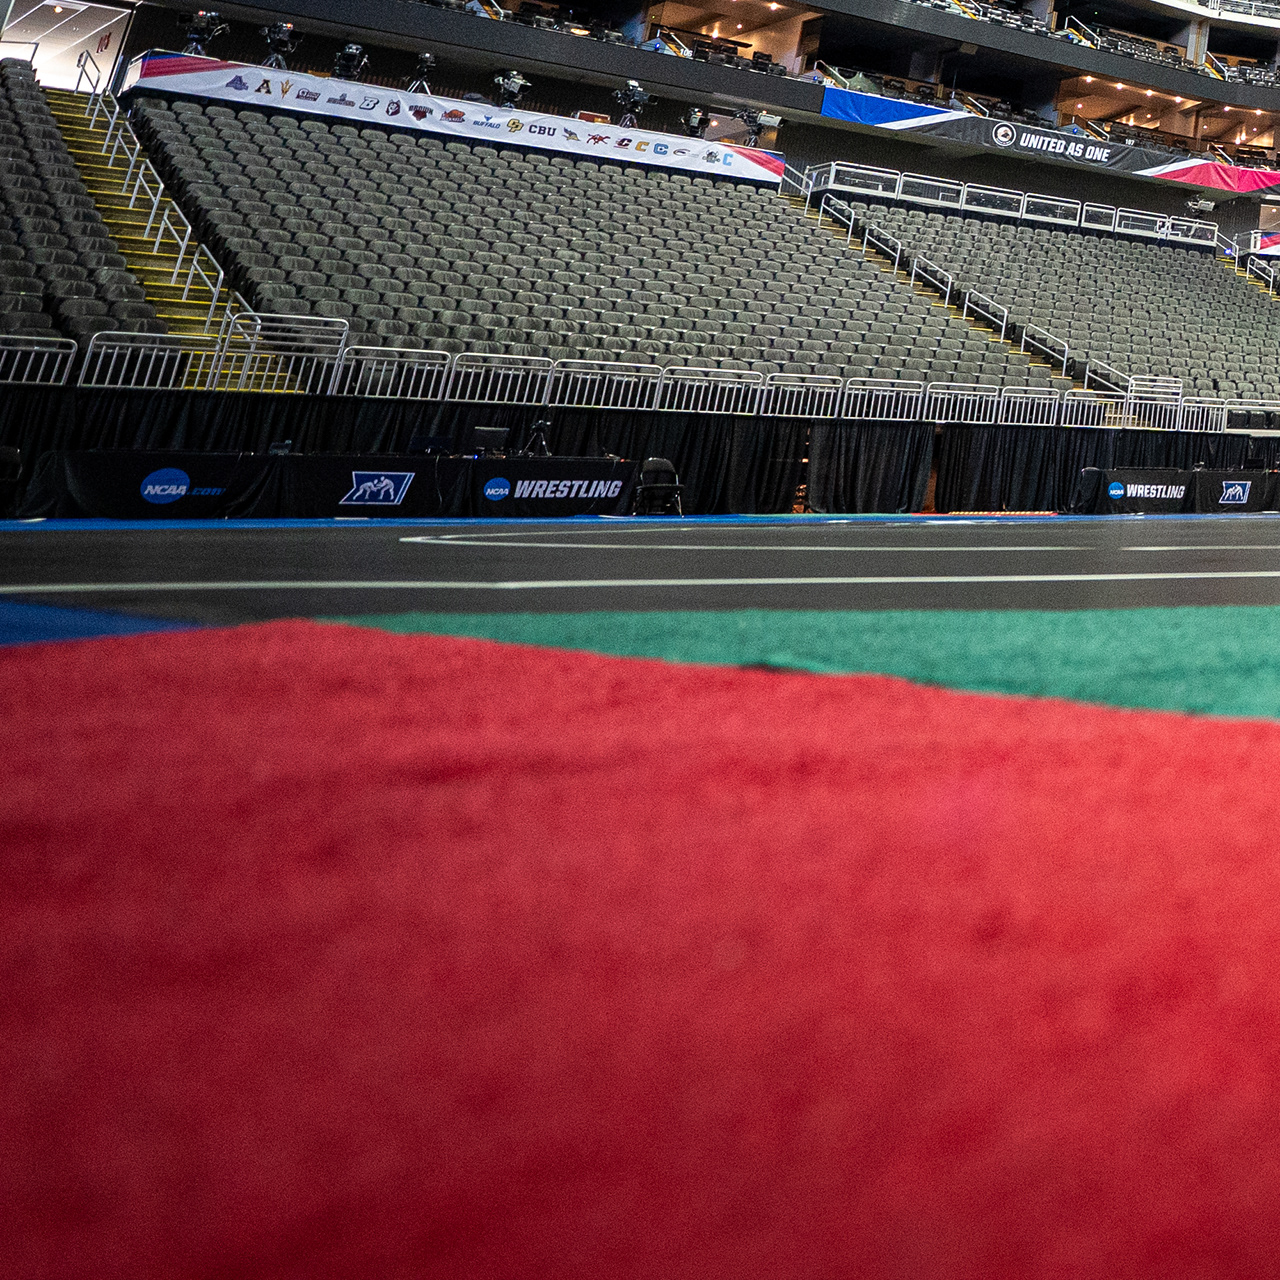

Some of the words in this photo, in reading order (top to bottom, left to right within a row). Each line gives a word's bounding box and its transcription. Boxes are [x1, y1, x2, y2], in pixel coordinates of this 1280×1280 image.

[255, 79, 272, 94] A
[359, 96, 380, 111] B
[472, 120, 501, 129] BUFFALO
[528, 124, 557, 137] CBU
[635, 141, 649, 152] C
[653, 143, 669, 155] C
[722, 153, 733, 166] C
[1019, 132, 1065, 153] UNITED
[1065, 142, 1085, 157] AS
[1085, 146, 1111, 162] ONE
[485, 487, 510, 496] NCAA
[513, 480, 624, 499] WRESTLING
[1126, 483, 1186, 499] WRESTLING
